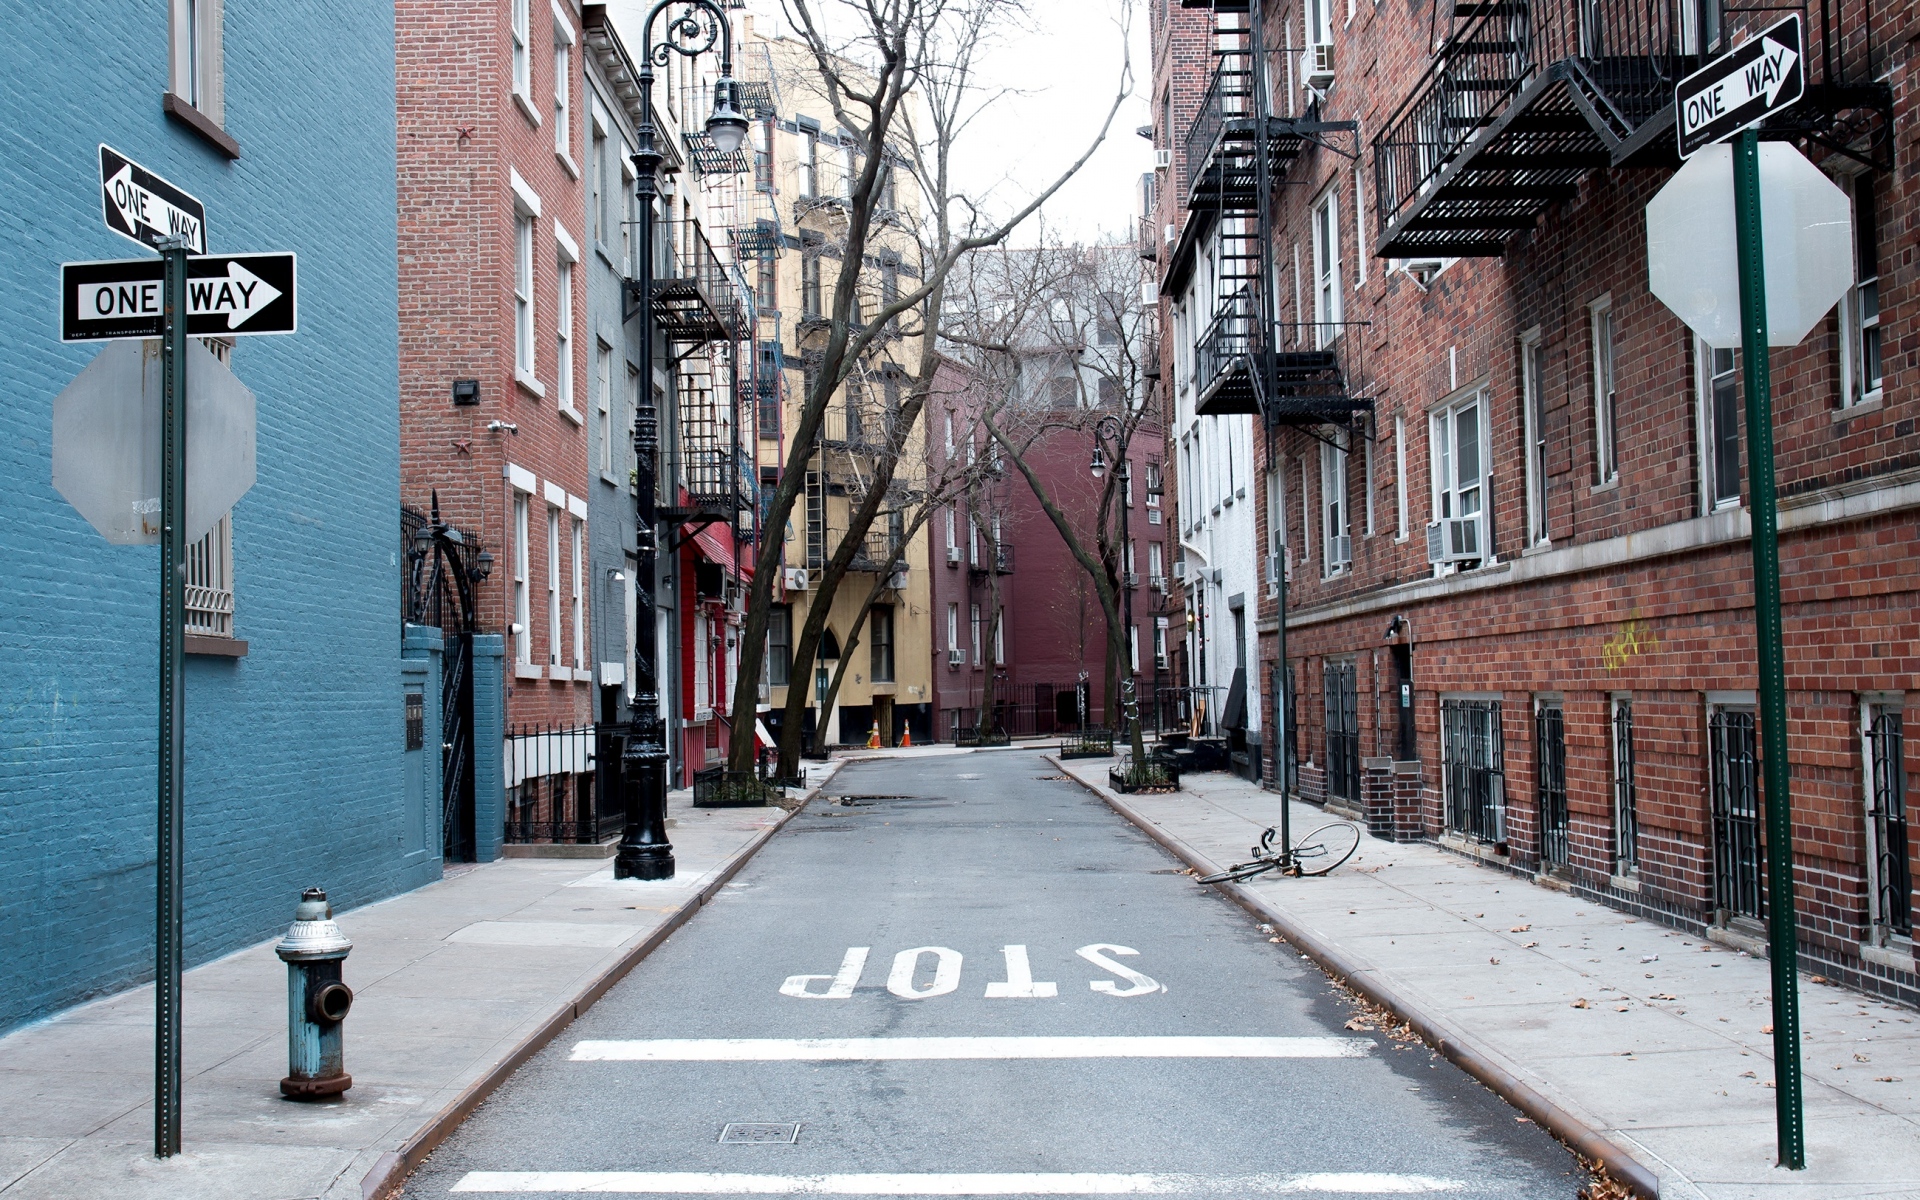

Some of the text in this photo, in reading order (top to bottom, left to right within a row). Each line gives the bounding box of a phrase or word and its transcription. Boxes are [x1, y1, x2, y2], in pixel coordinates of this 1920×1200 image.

[1688, 48, 1784, 129] ONE WAY
[115, 179, 197, 247] ONE WAY
[96, 281, 258, 315] ONE WAY
[105, 328, 157, 336] TRANSPORTATION
[779, 942, 1168, 999] STOP
